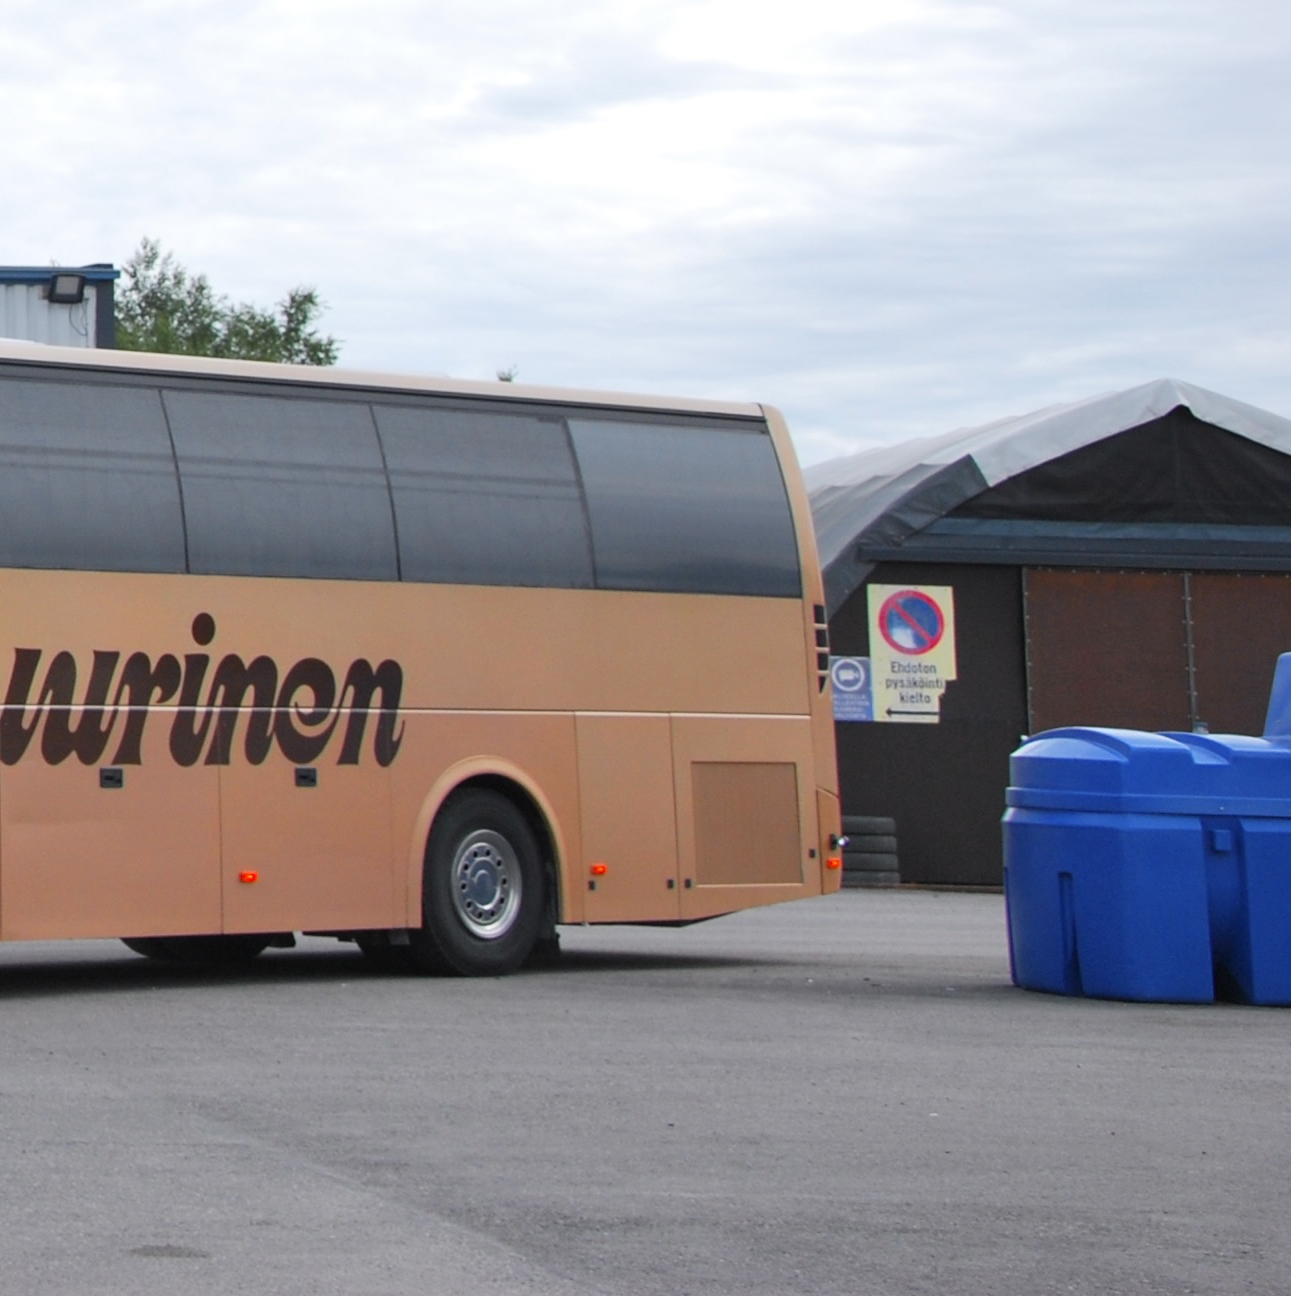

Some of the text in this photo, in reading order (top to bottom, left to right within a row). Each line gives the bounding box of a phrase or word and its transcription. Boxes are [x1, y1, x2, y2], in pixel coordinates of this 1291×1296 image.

[891, 661, 937, 673] Ehdoton
[885, 677, 943, 689] pysäköinti
[899, 693, 931, 704] kielto
